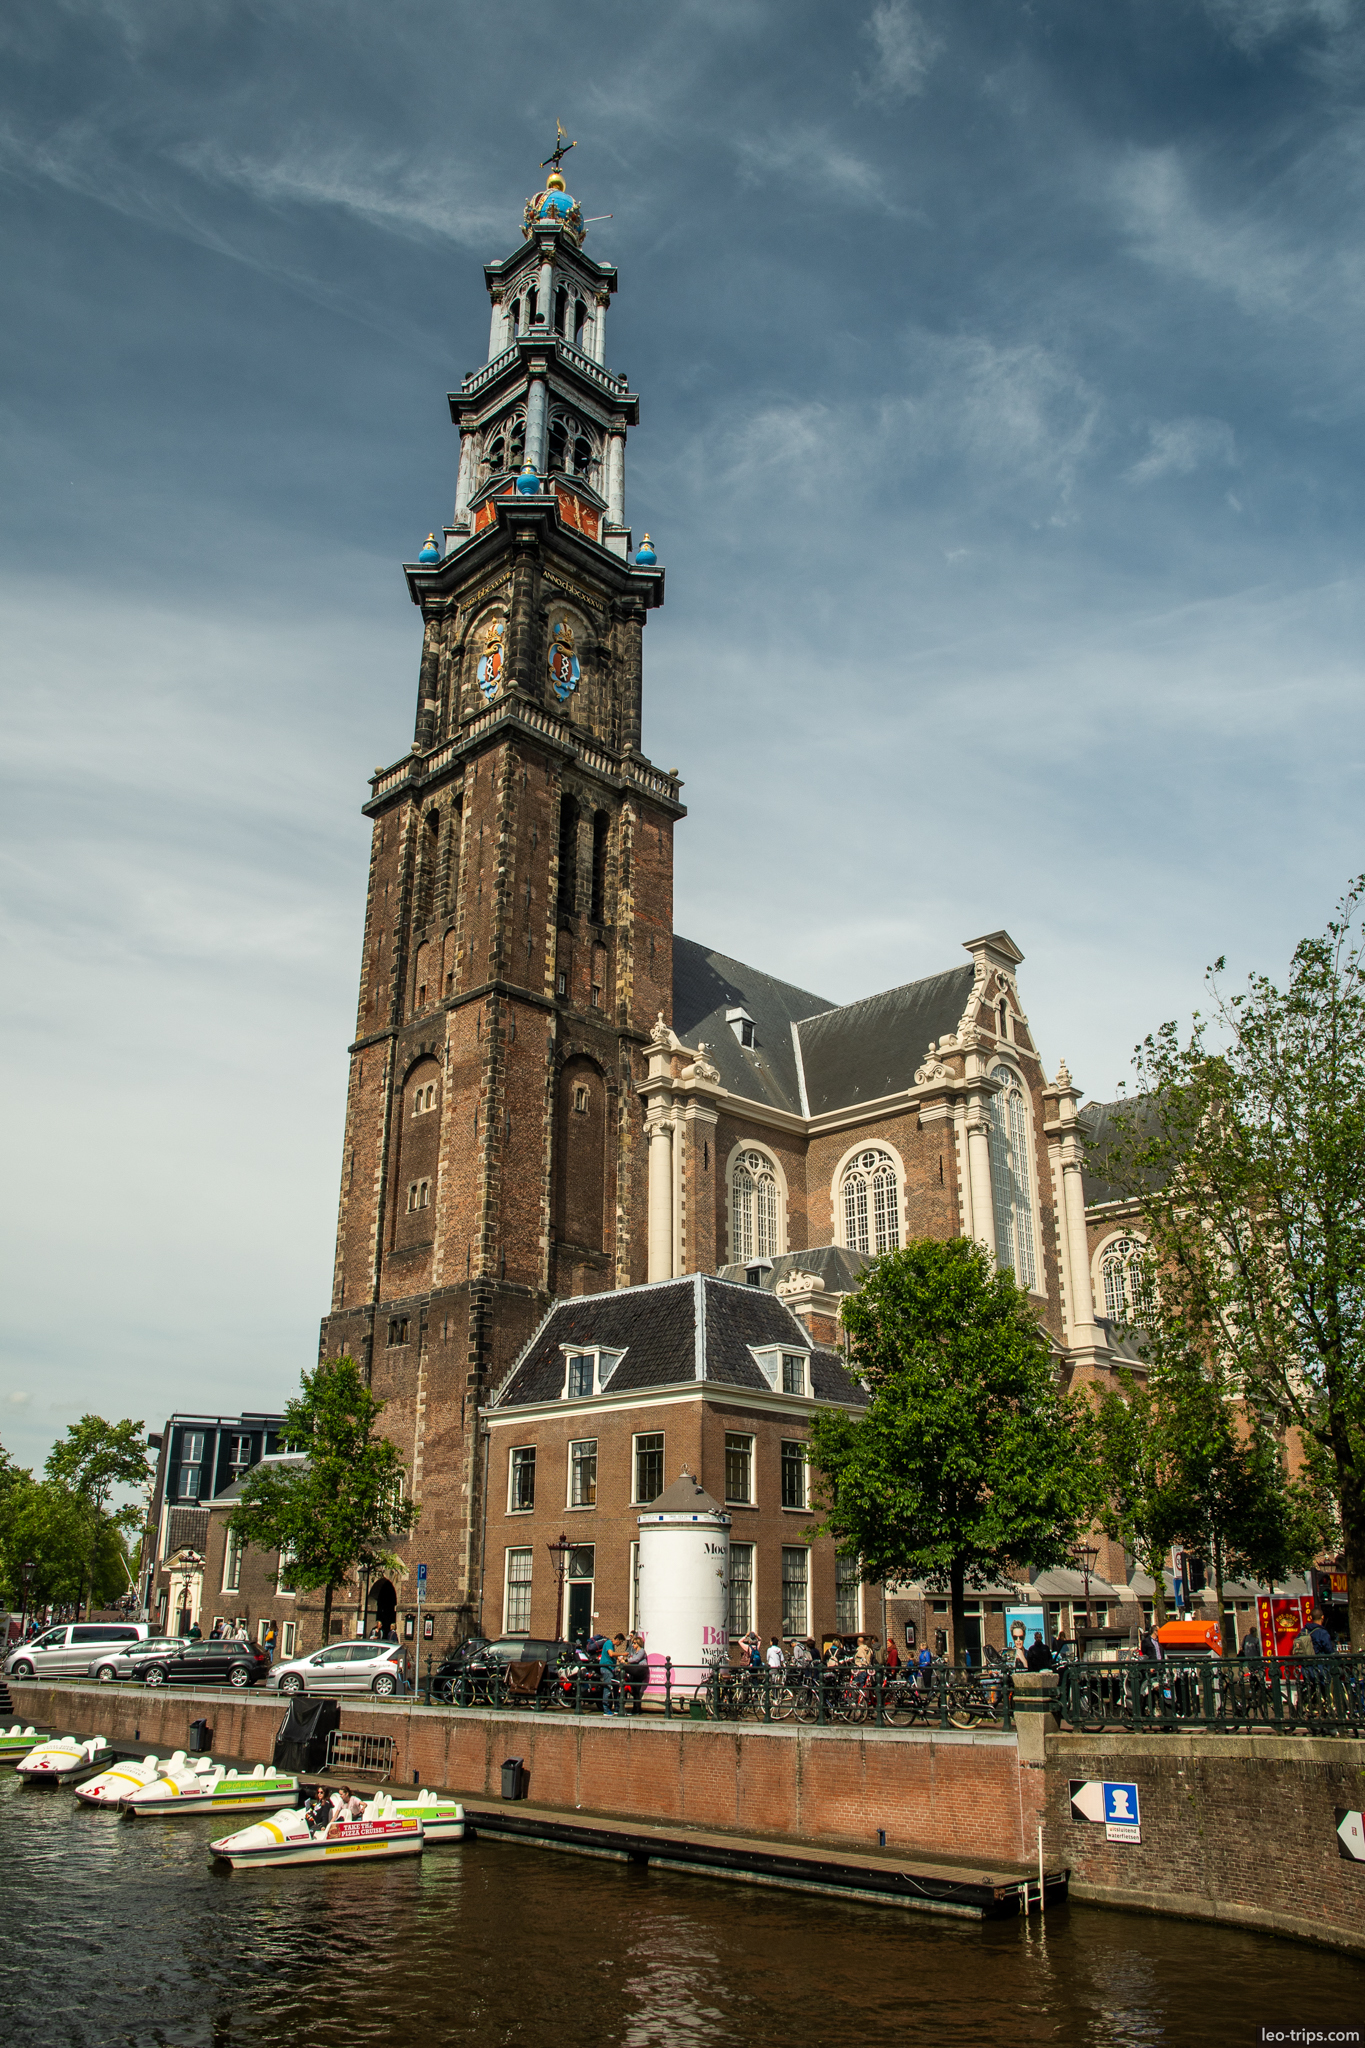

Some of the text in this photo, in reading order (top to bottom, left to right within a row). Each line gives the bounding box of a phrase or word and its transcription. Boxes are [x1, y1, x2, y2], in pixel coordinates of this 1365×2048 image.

[1330, 1574, 1347, 1591] T-DO
[1304, 1601, 1312, 1622] COL
[1261, 1602, 1273, 1657] HOT-DO
[413, 1808, 424, 1816] OFF
[341, 1829, 360, 1837] PIZZA
[360, 1827, 385, 1836] CRUISE!
[360, 1822, 374, 1830] THE
